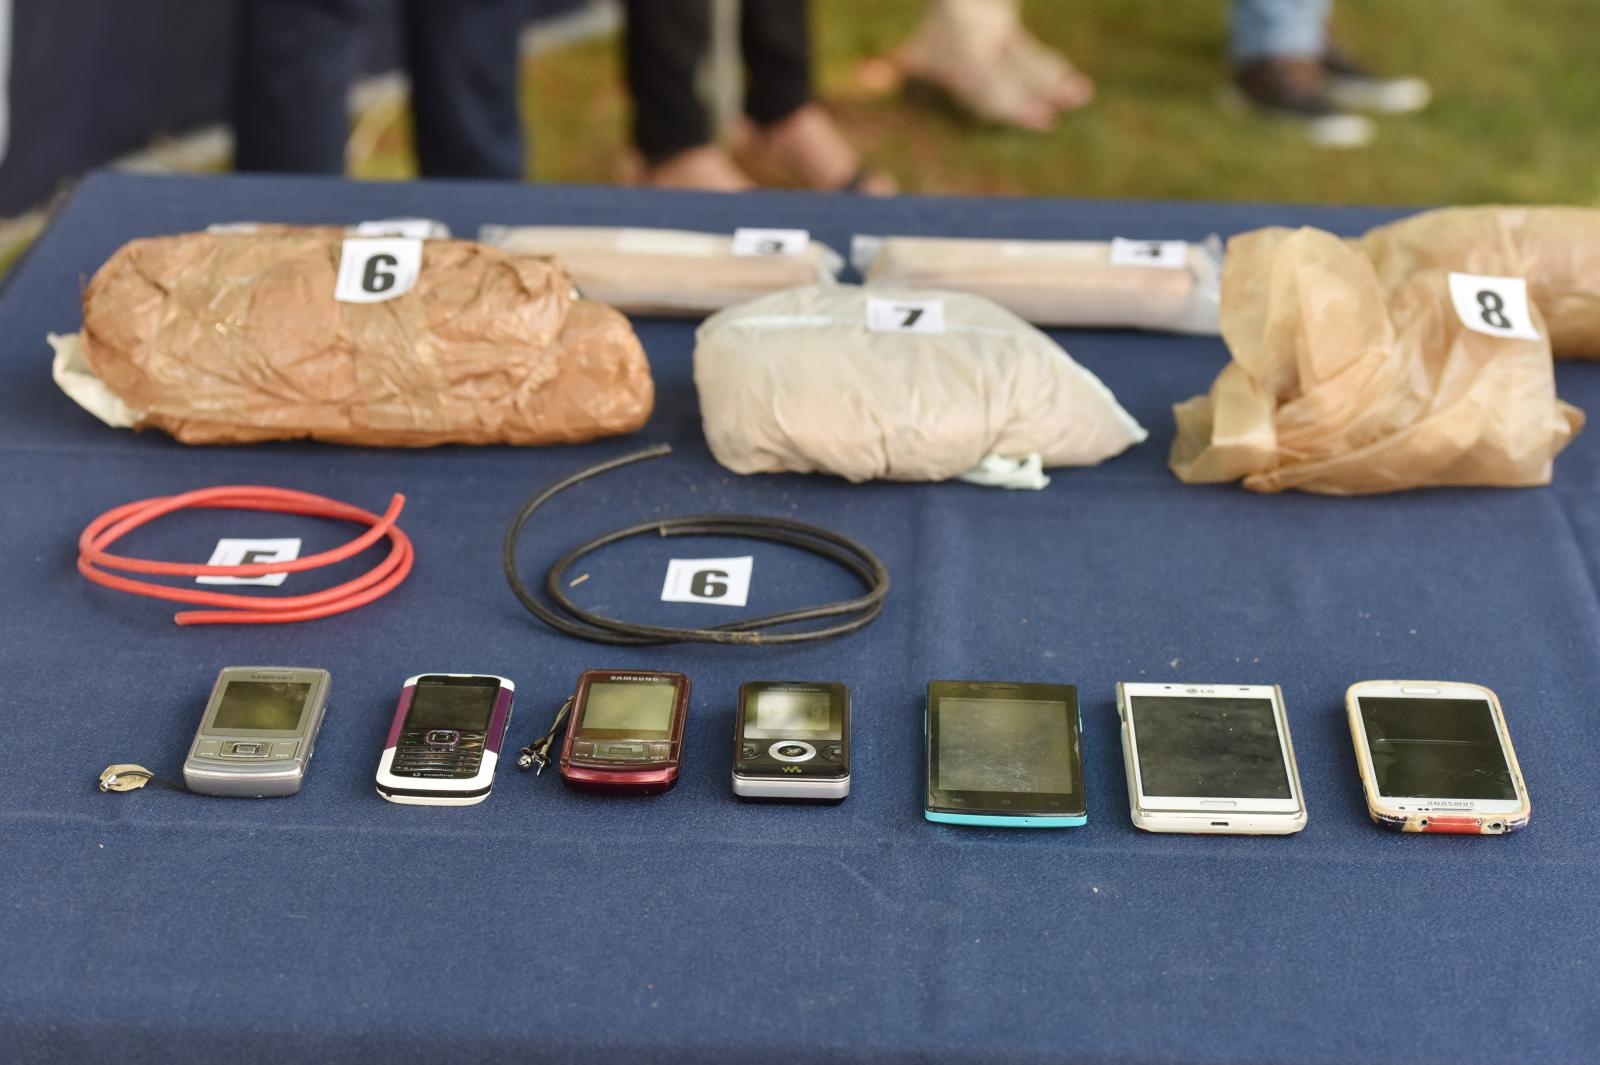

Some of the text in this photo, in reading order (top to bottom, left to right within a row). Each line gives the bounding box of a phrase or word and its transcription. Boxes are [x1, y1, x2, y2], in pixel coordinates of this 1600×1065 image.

[361, 253, 398, 293] 6
[893, 304, 925, 328] 7
[1476, 289, 1512, 329] 8
[689, 569, 729, 598] 6
